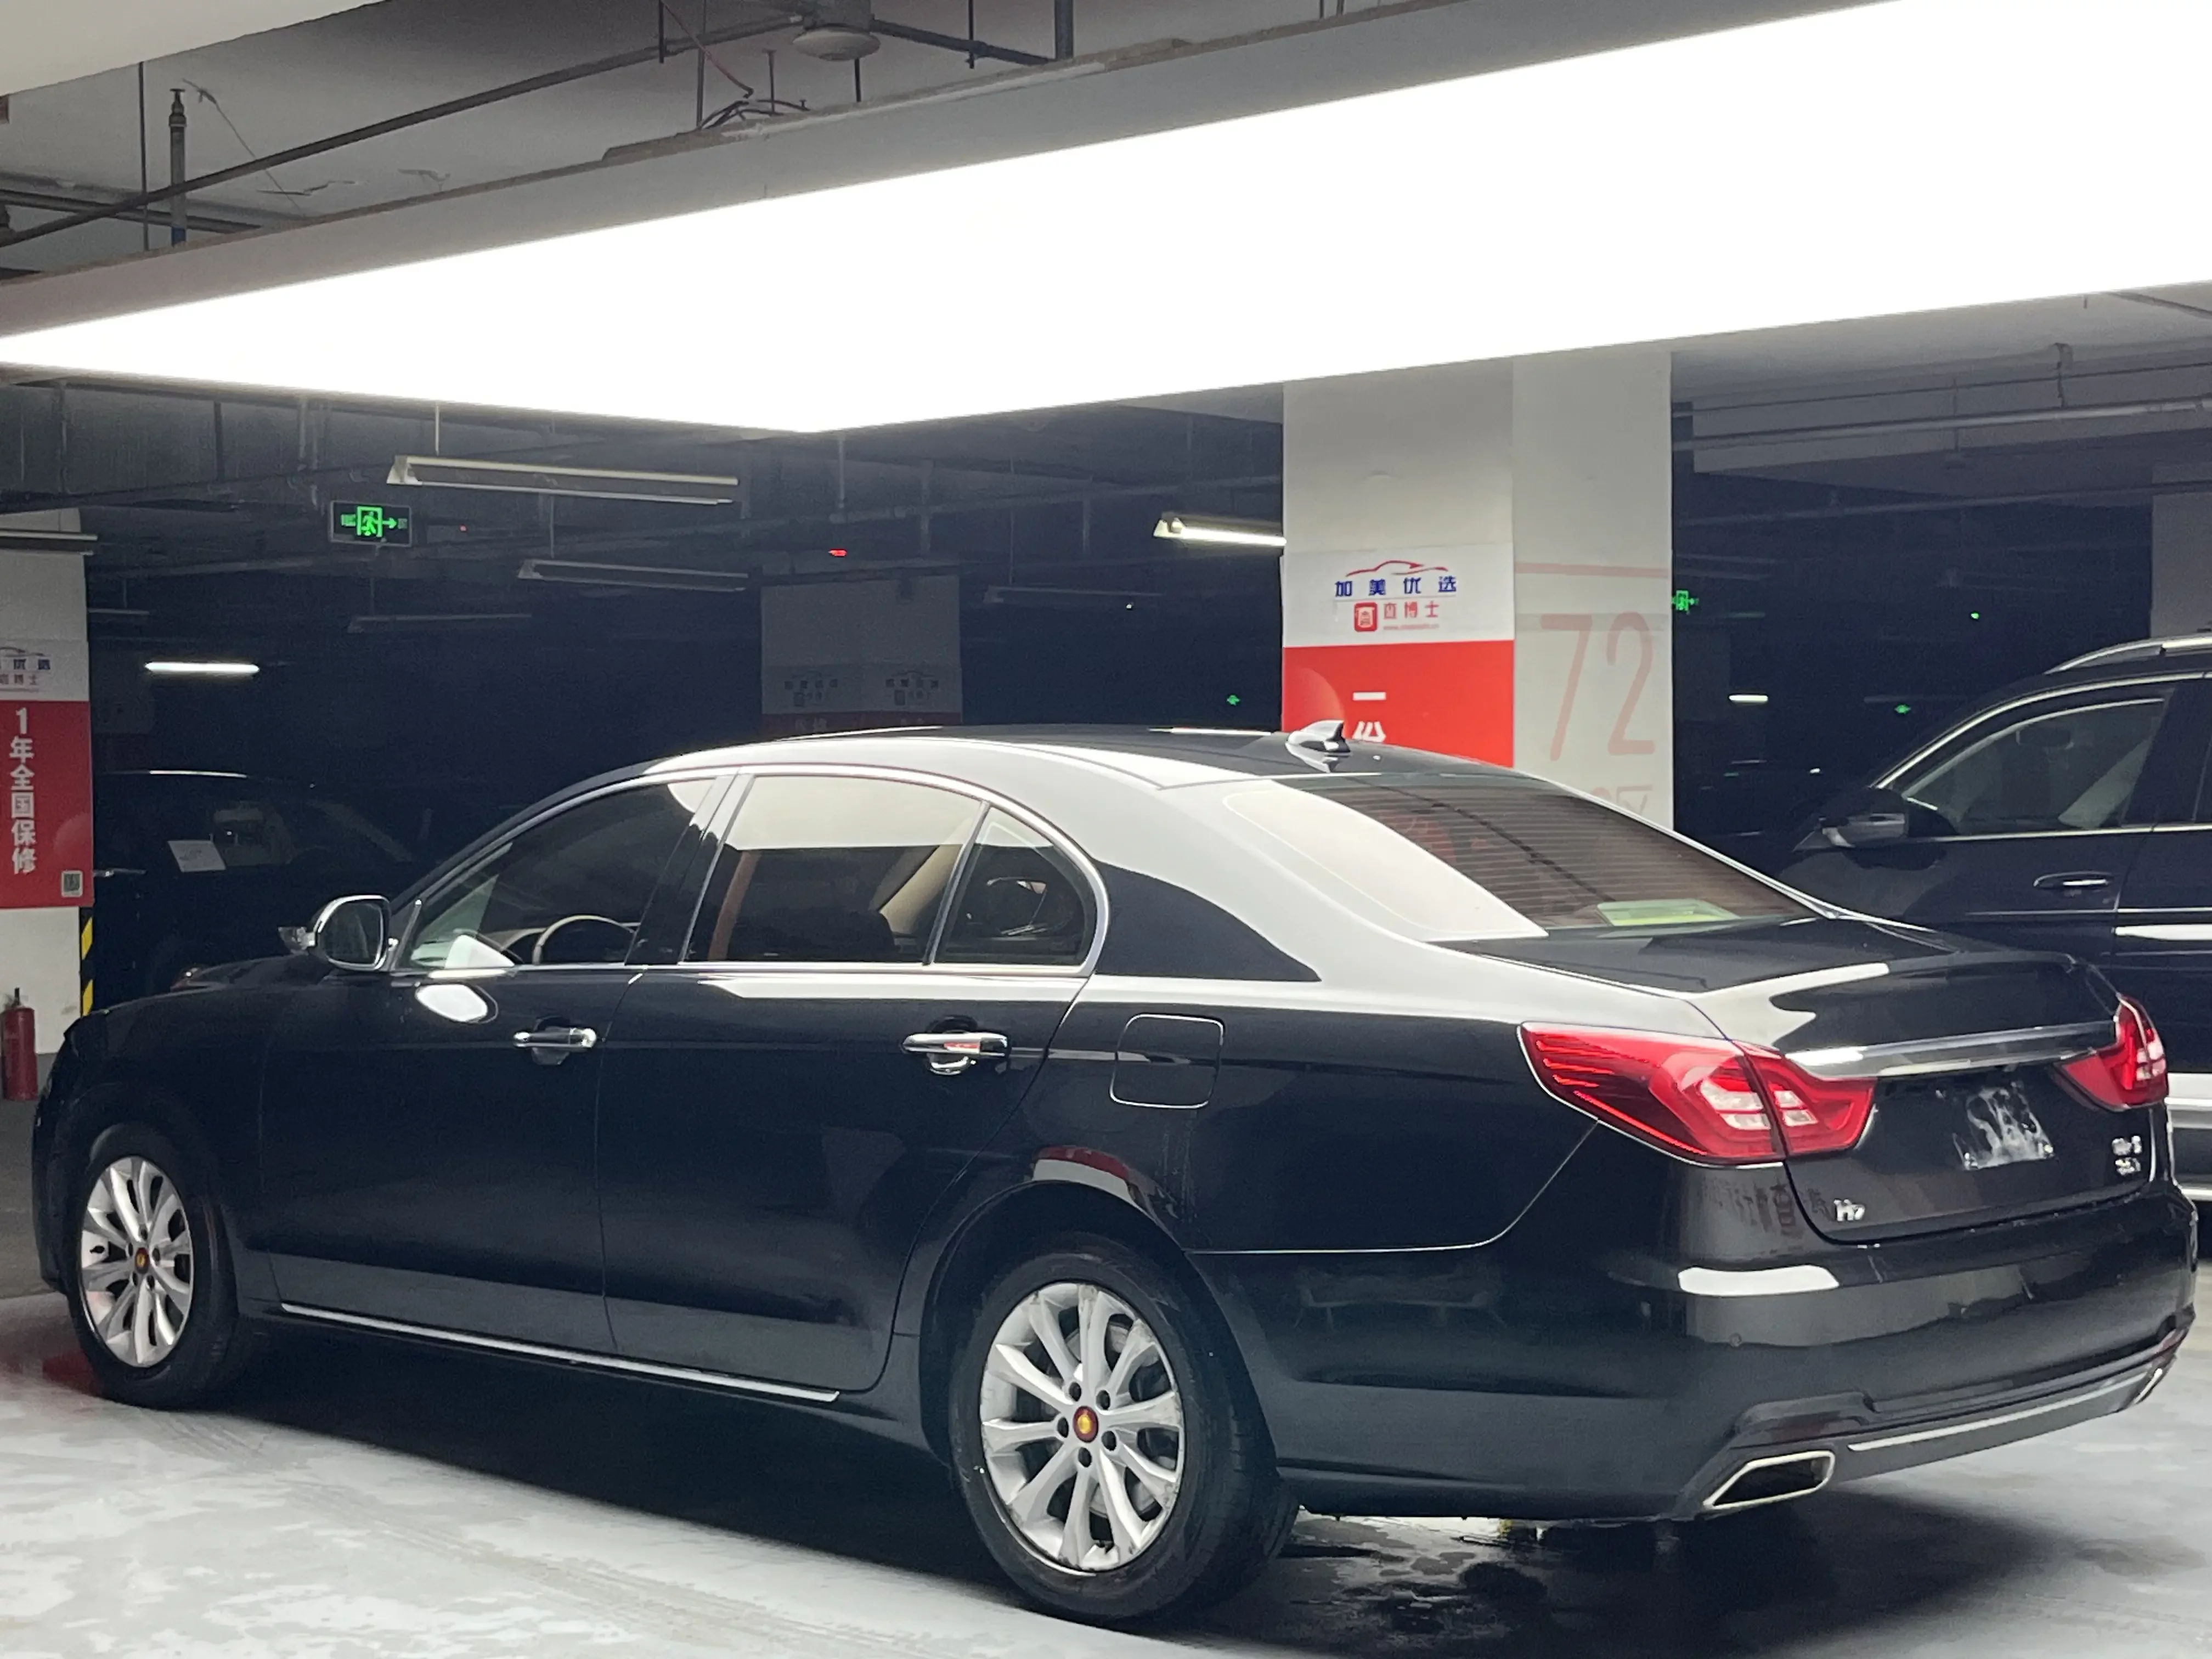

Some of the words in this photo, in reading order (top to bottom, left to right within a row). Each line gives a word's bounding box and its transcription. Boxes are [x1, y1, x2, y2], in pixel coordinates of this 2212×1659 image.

[1335, 575, 1456, 597] 加美优选
[1540, 611, 1656, 761] 72
[9, 707, 37, 874] 1年全国保修
